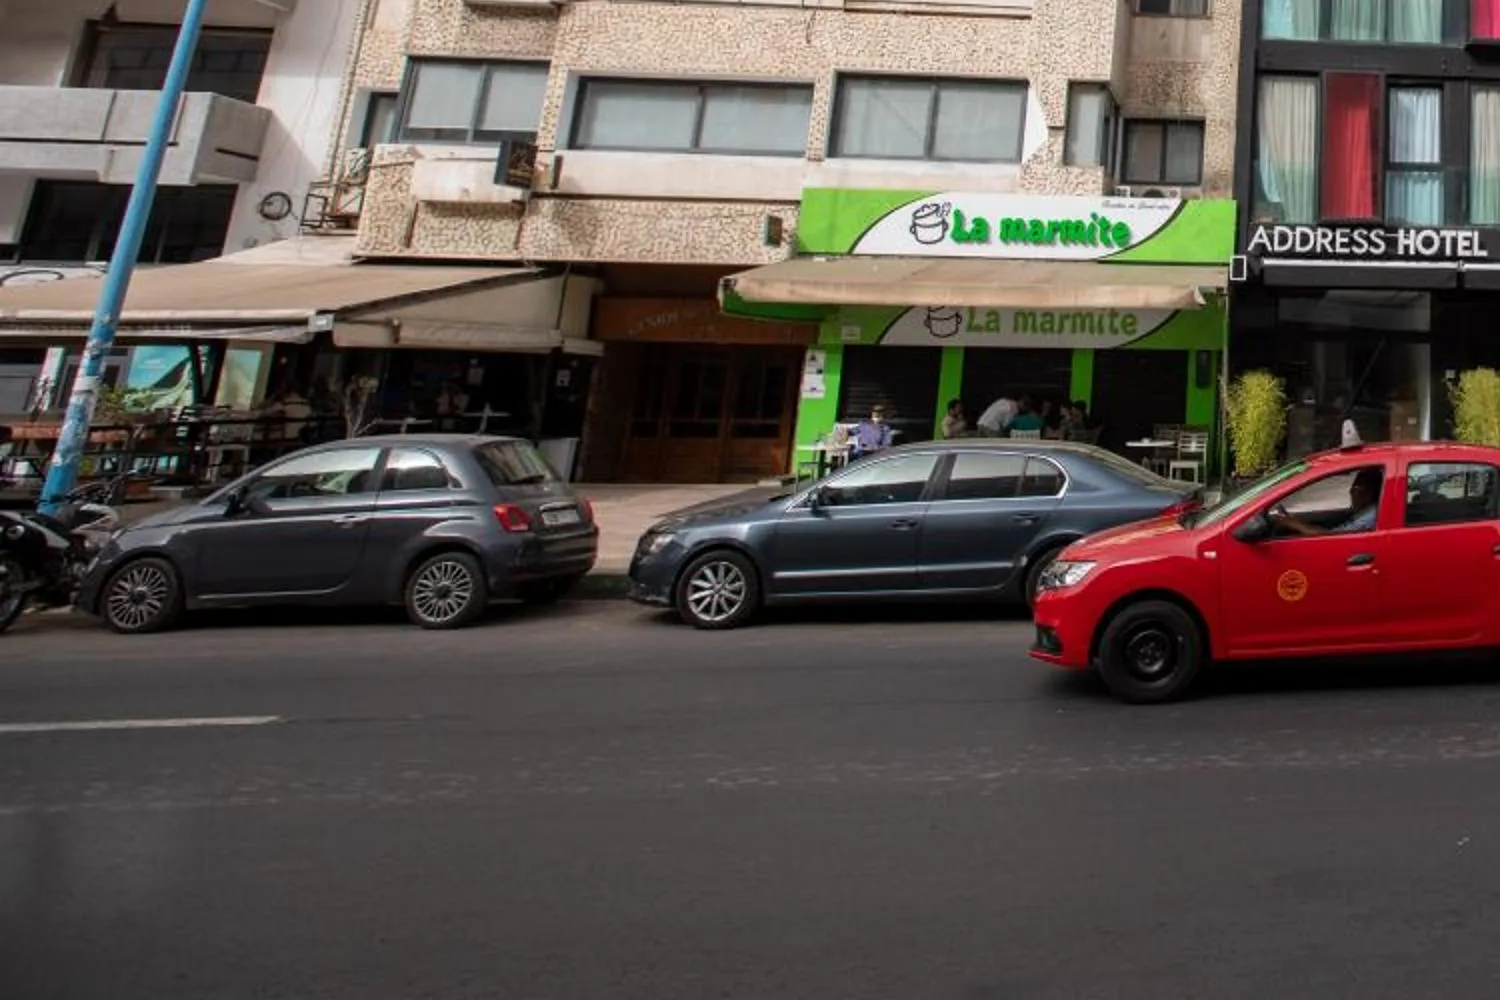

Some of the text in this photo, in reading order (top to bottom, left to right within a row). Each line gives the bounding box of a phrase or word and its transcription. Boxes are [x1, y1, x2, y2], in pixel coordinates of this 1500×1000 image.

[951, 208, 1132, 249] La marmite
[1247, 225, 1488, 257] ADDRESS HOTEL
[966, 306, 1138, 335] La marmite
